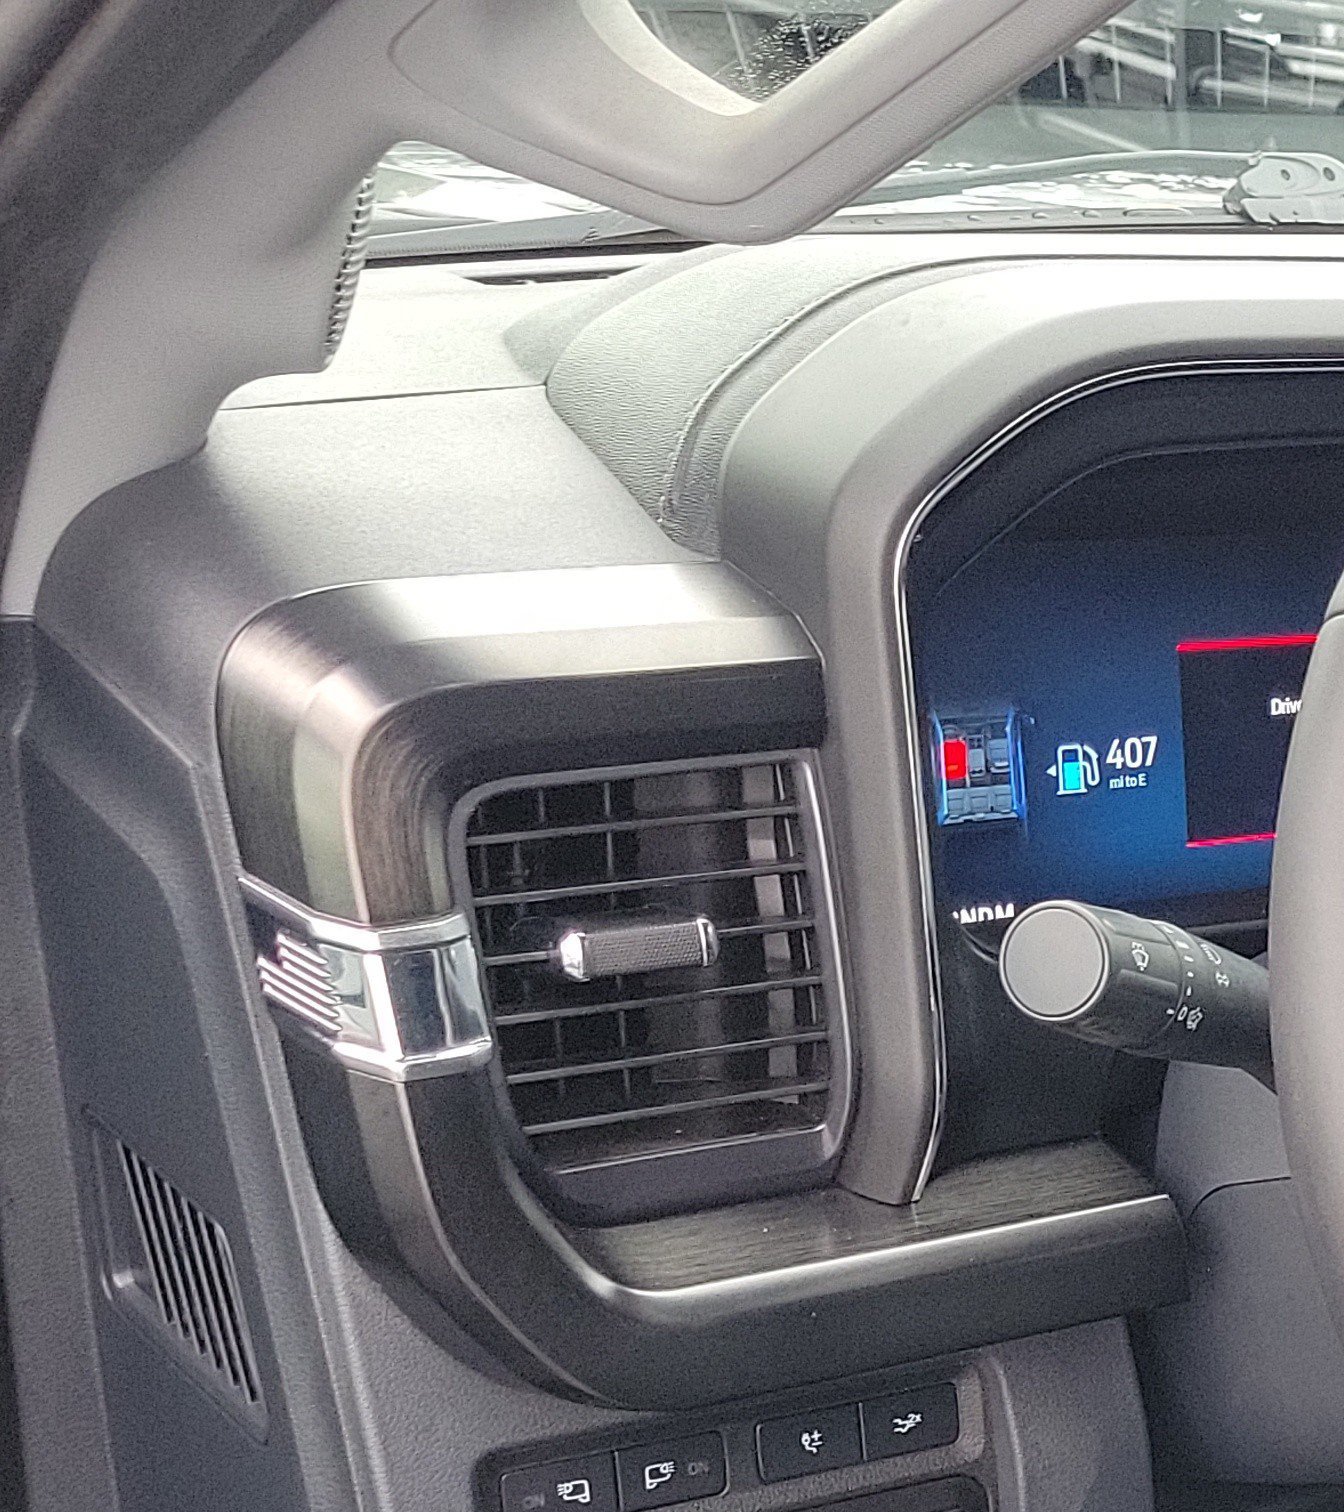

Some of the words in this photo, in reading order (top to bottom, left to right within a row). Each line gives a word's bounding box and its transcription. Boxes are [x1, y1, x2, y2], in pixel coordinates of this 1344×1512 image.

[1105, 735, 1159, 770] 407
[1109, 775, 1123, 789] mi
[1125, 774, 1138, 788] to
[1138, 773, 1148, 787] E
